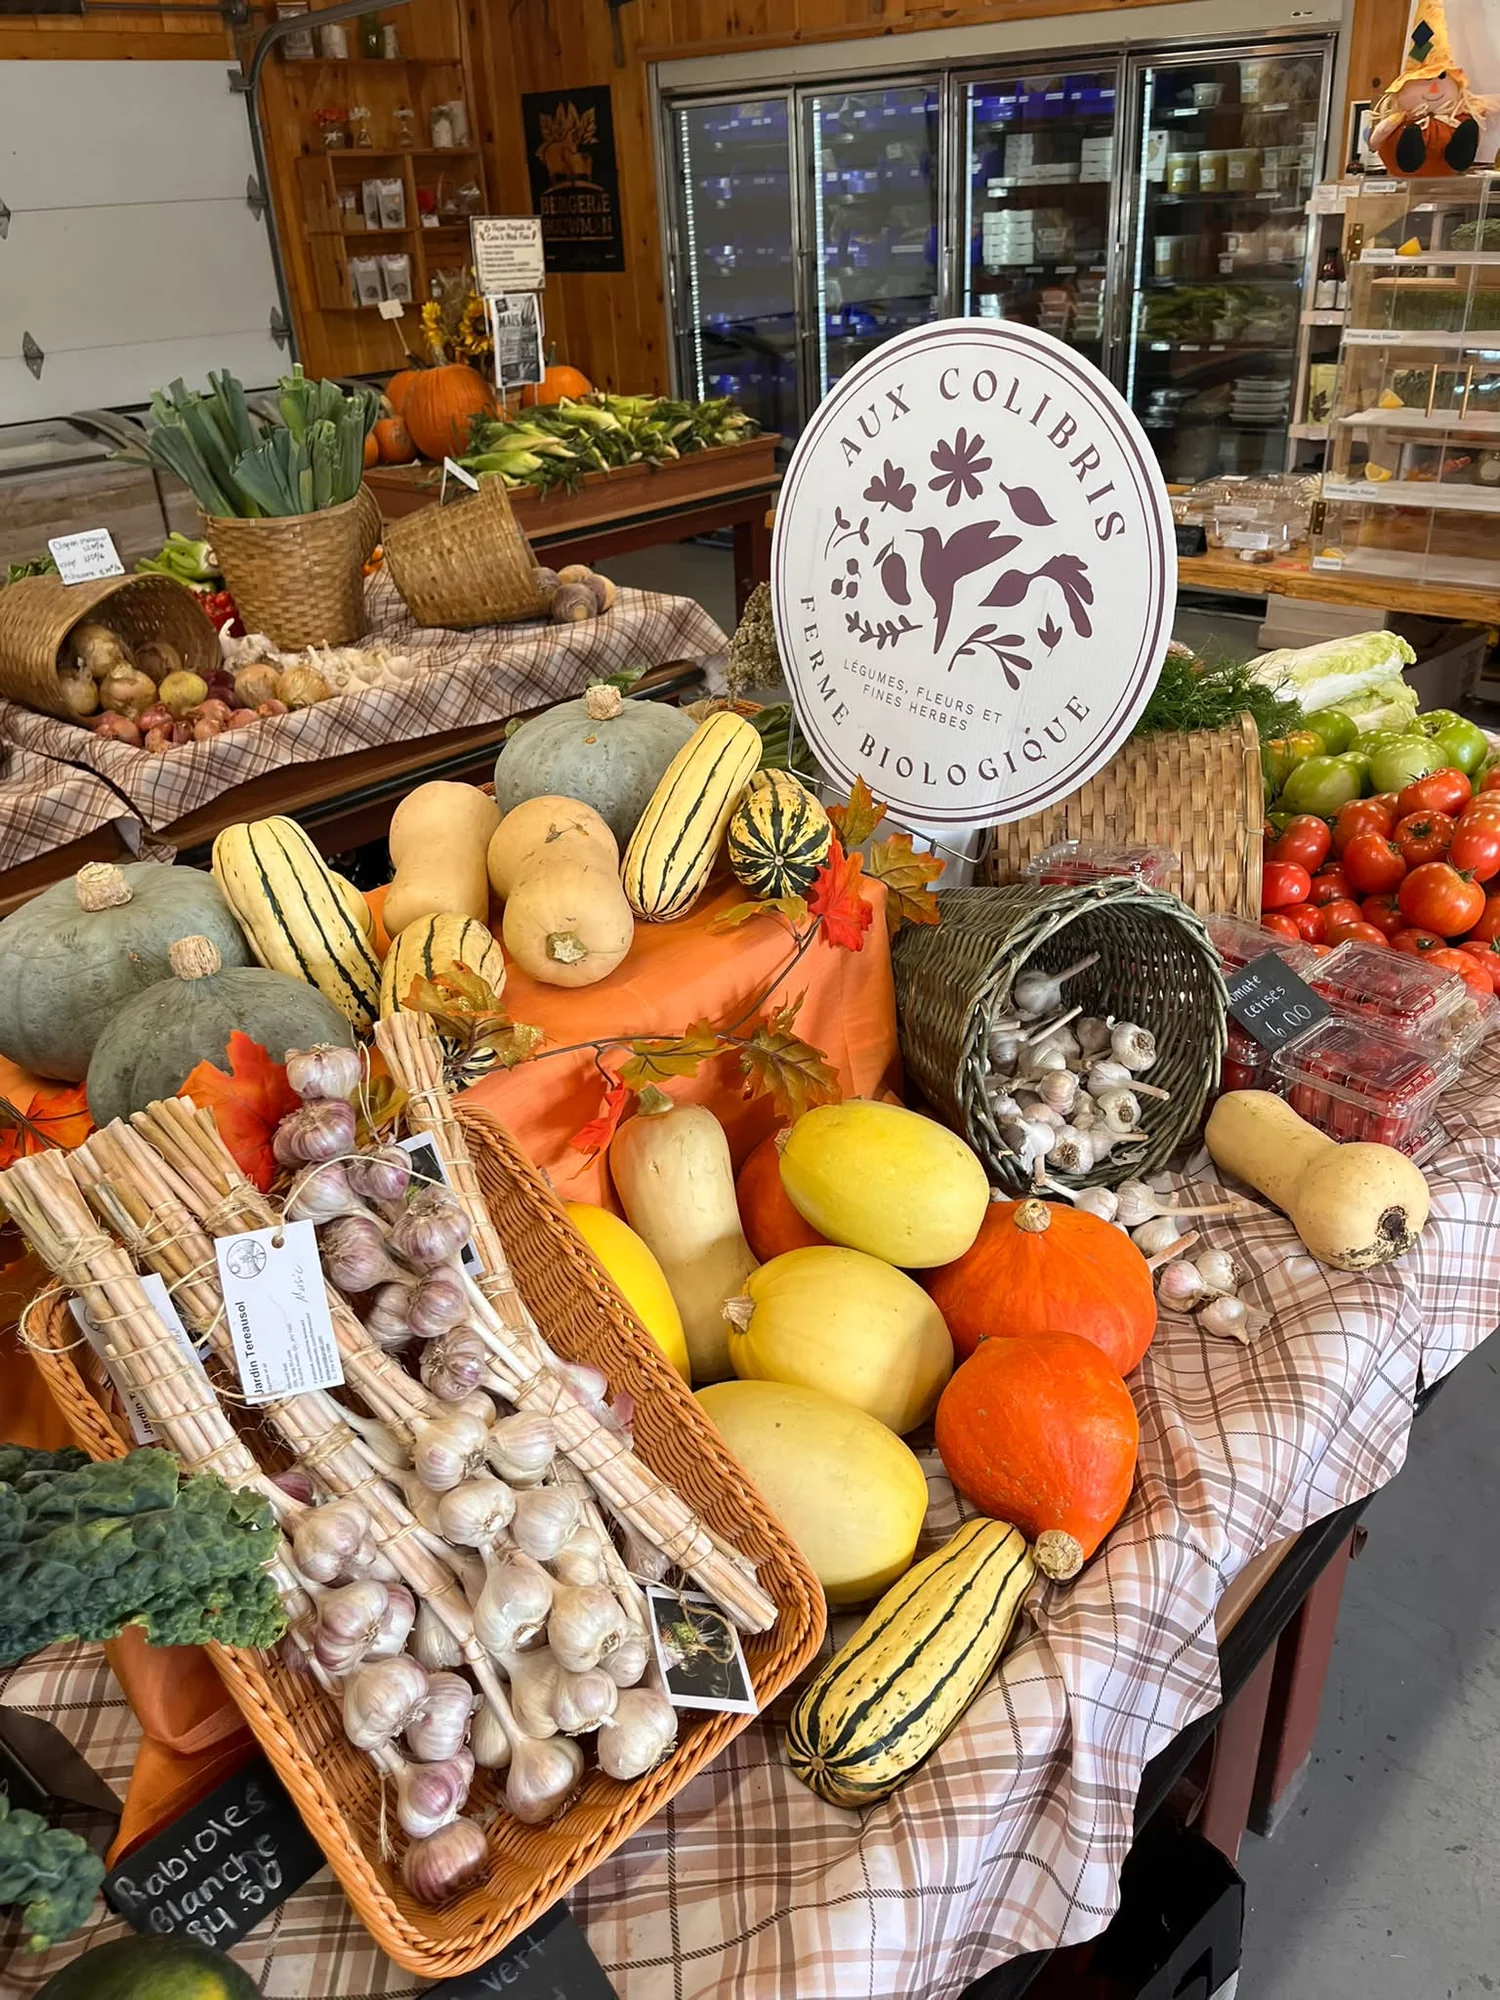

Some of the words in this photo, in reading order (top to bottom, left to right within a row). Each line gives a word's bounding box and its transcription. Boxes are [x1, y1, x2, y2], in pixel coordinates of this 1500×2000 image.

[840, 384, 911, 467] AUX
[939, 367, 1126, 542] COLIBRIS
[800, 596, 850, 726] FERME
[859, 695, 1091, 787] BIOLOGIQUE
[843, 658, 909, 695] LÉGUMES,
[916, 686, 974, 716] FLEURS
[982, 709, 1002, 724] ET
[862, 683, 902, 708] FINES
[909, 702, 968, 731] HERBES
[1229, 974, 1262, 1006] omate
[1243, 985, 1286, 1018] cerises
[235, 1300, 255, 1358] Tereausol
[249, 1360, 264, 1394] Jardin
[135, 1402, 154, 1435] Jardin
[114, 1781, 267, 1908] Rabioles
